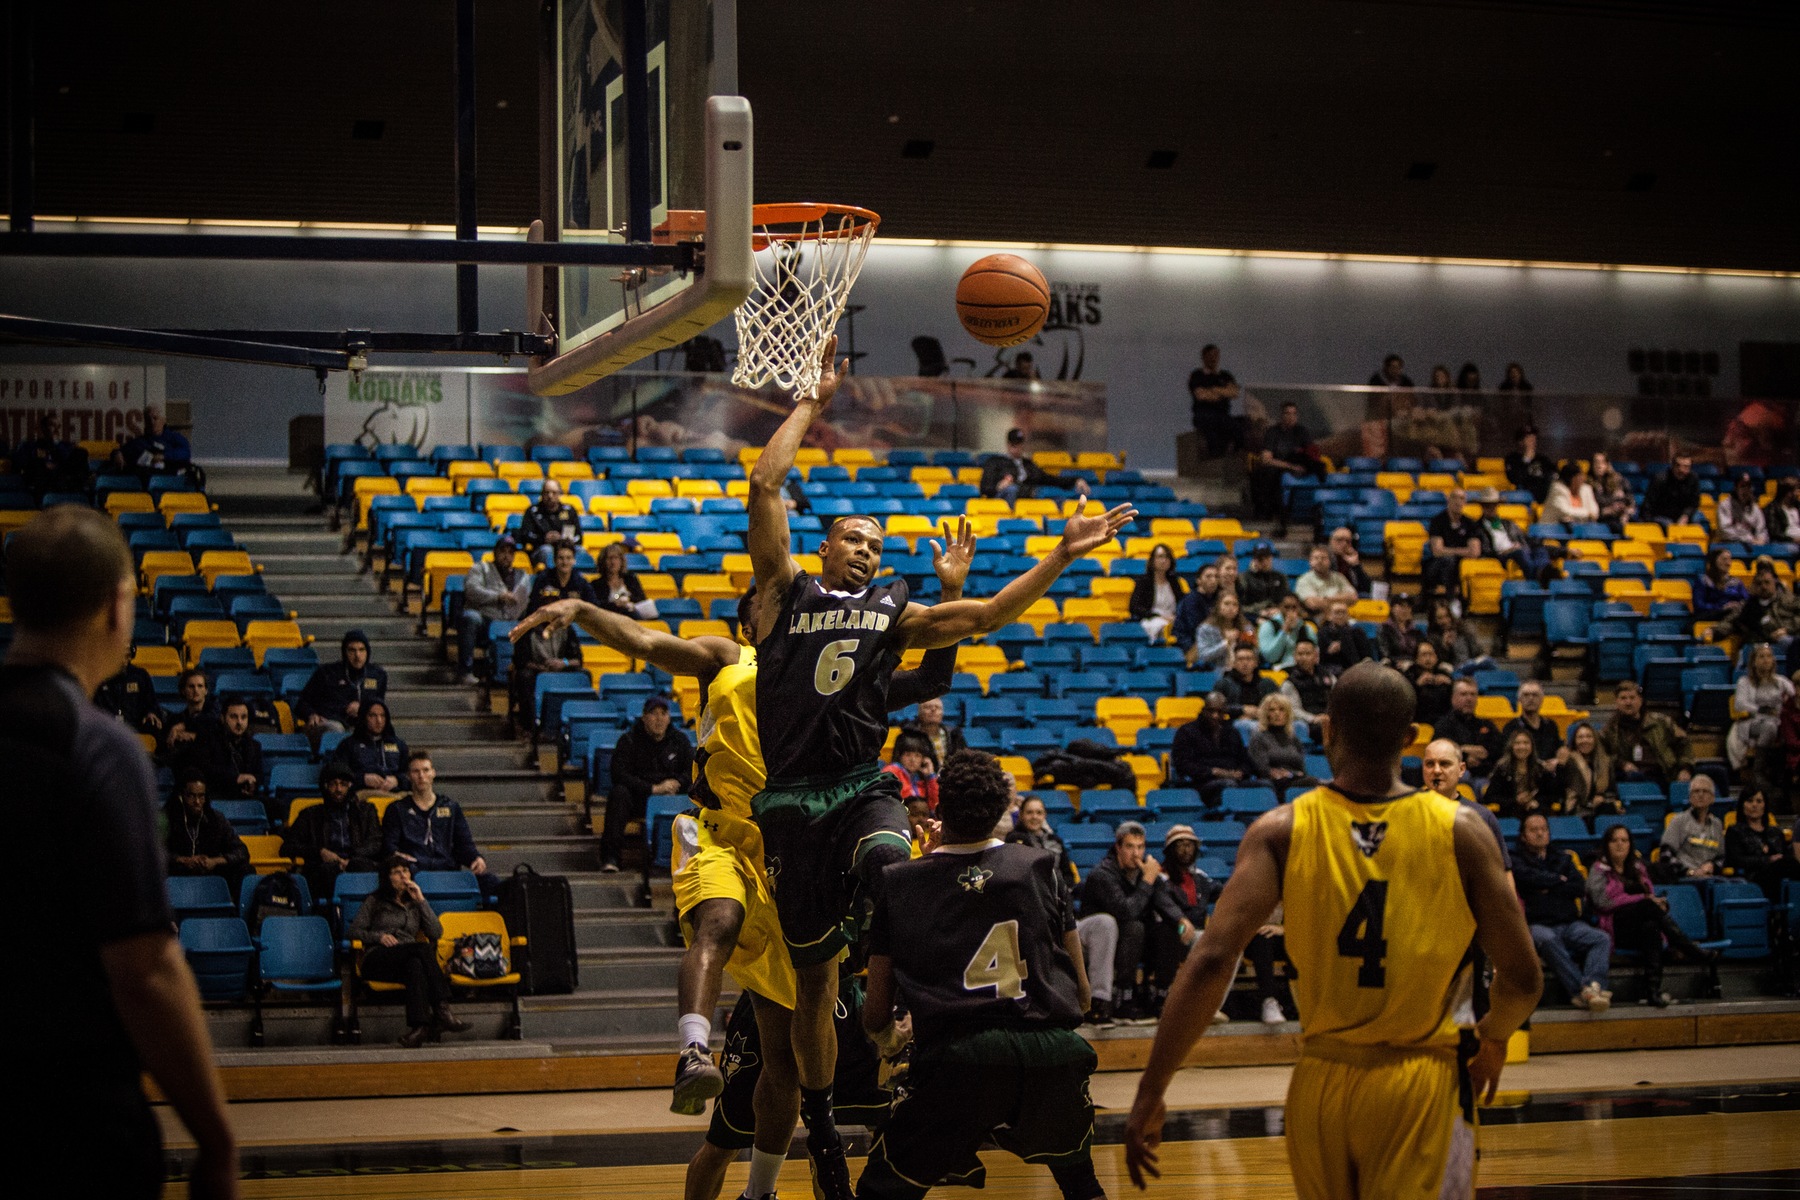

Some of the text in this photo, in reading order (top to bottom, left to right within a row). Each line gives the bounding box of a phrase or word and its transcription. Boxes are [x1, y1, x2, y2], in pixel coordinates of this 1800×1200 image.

[109, 380, 130, 399] OF
[348, 378, 442, 402] KODIAKS
[788, 609, 890, 635] LAKELAND
[814, 639, 860, 695] 6
[1338, 880, 1387, 987] 4
[963, 920, 1028, 1000] 4
